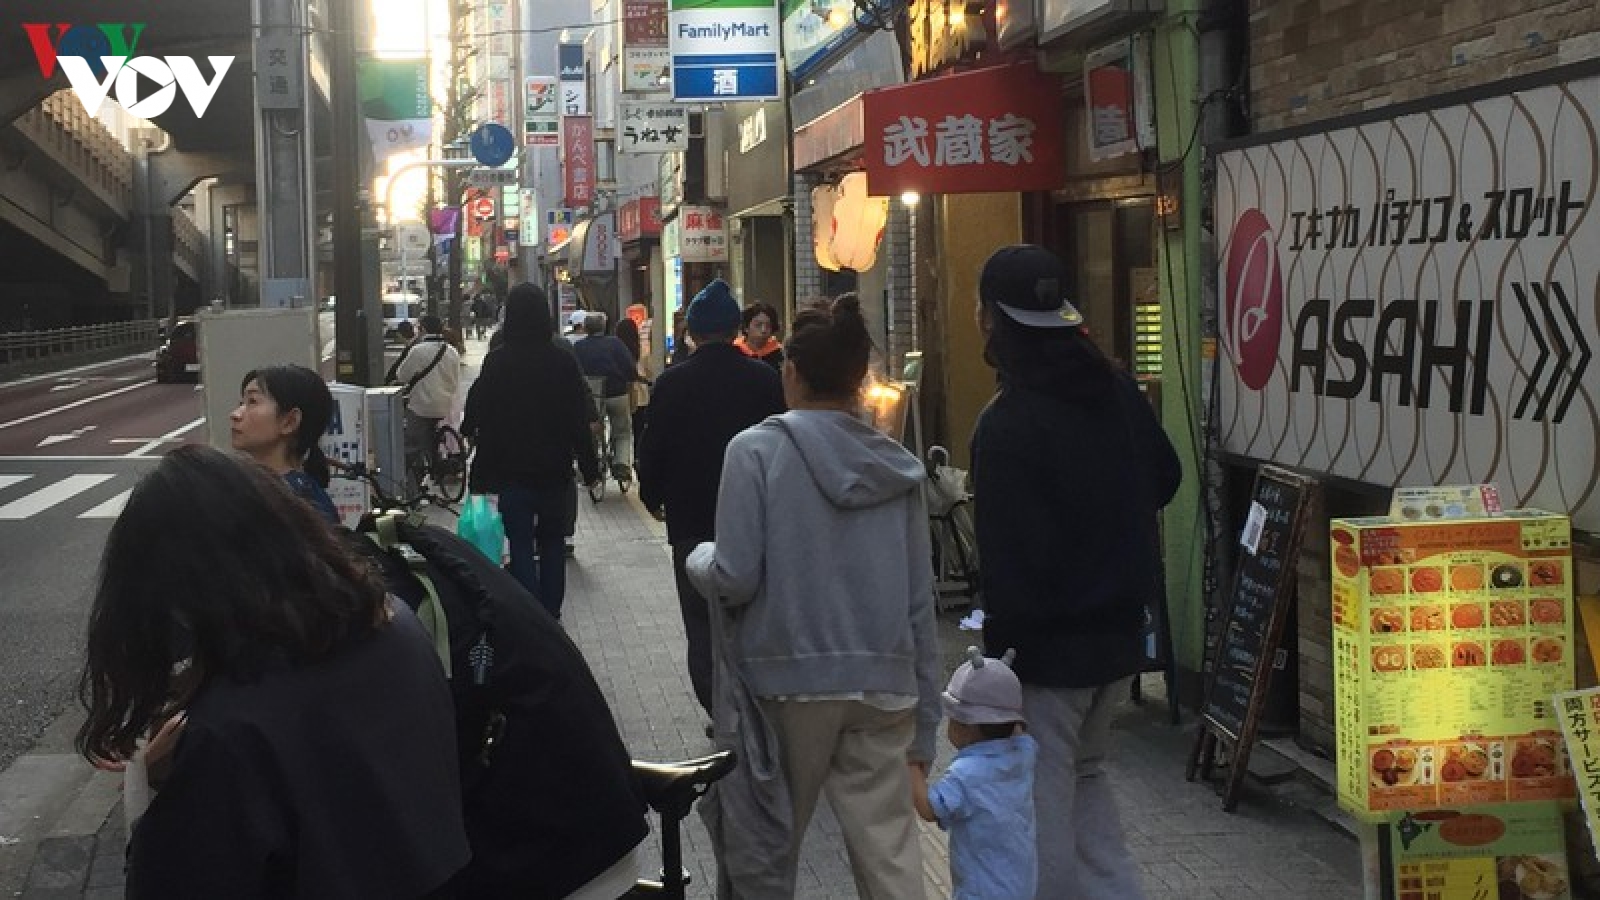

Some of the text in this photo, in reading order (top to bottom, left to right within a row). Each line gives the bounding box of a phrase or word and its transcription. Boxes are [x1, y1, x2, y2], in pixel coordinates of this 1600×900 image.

[677, 23, 770, 42] FamilyMart
[268, 48, 288, 95] 交通
[713, 69, 738, 95] 酒
[624, 124, 682, 144] うね女
[882, 112, 1037, 168] 武蔵家
[686, 211, 723, 230] 麻雀
[1289, 180, 1585, 250] エキナカ パチンコ & スロット
[1290, 299, 1495, 416] ASAHI
